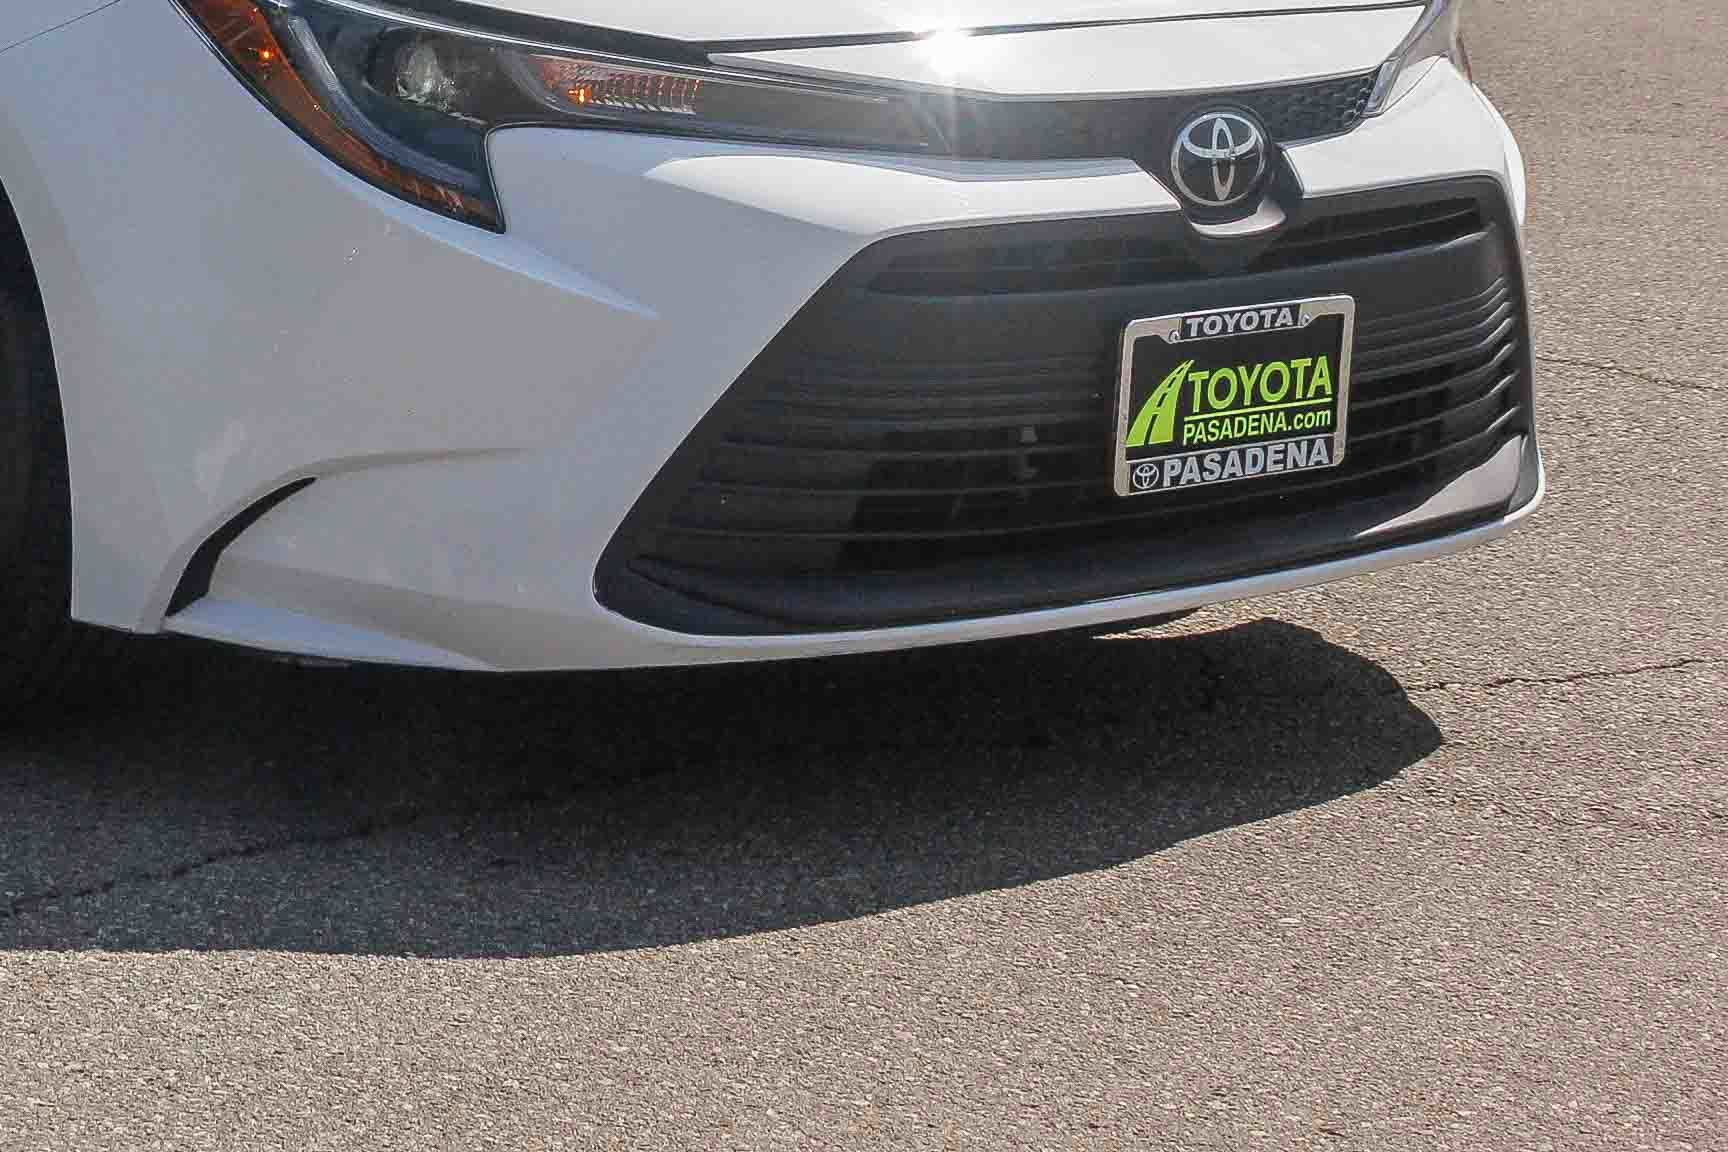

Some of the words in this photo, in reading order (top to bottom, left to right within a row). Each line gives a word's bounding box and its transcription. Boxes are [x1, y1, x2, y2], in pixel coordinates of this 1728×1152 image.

[1186, 307, 1293, 337] TOYOTA
[1188, 355, 1333, 413] TOYOTA
[1182, 409, 1332, 446] PASADENA.com
[1163, 438, 1330, 487] PASADENA
